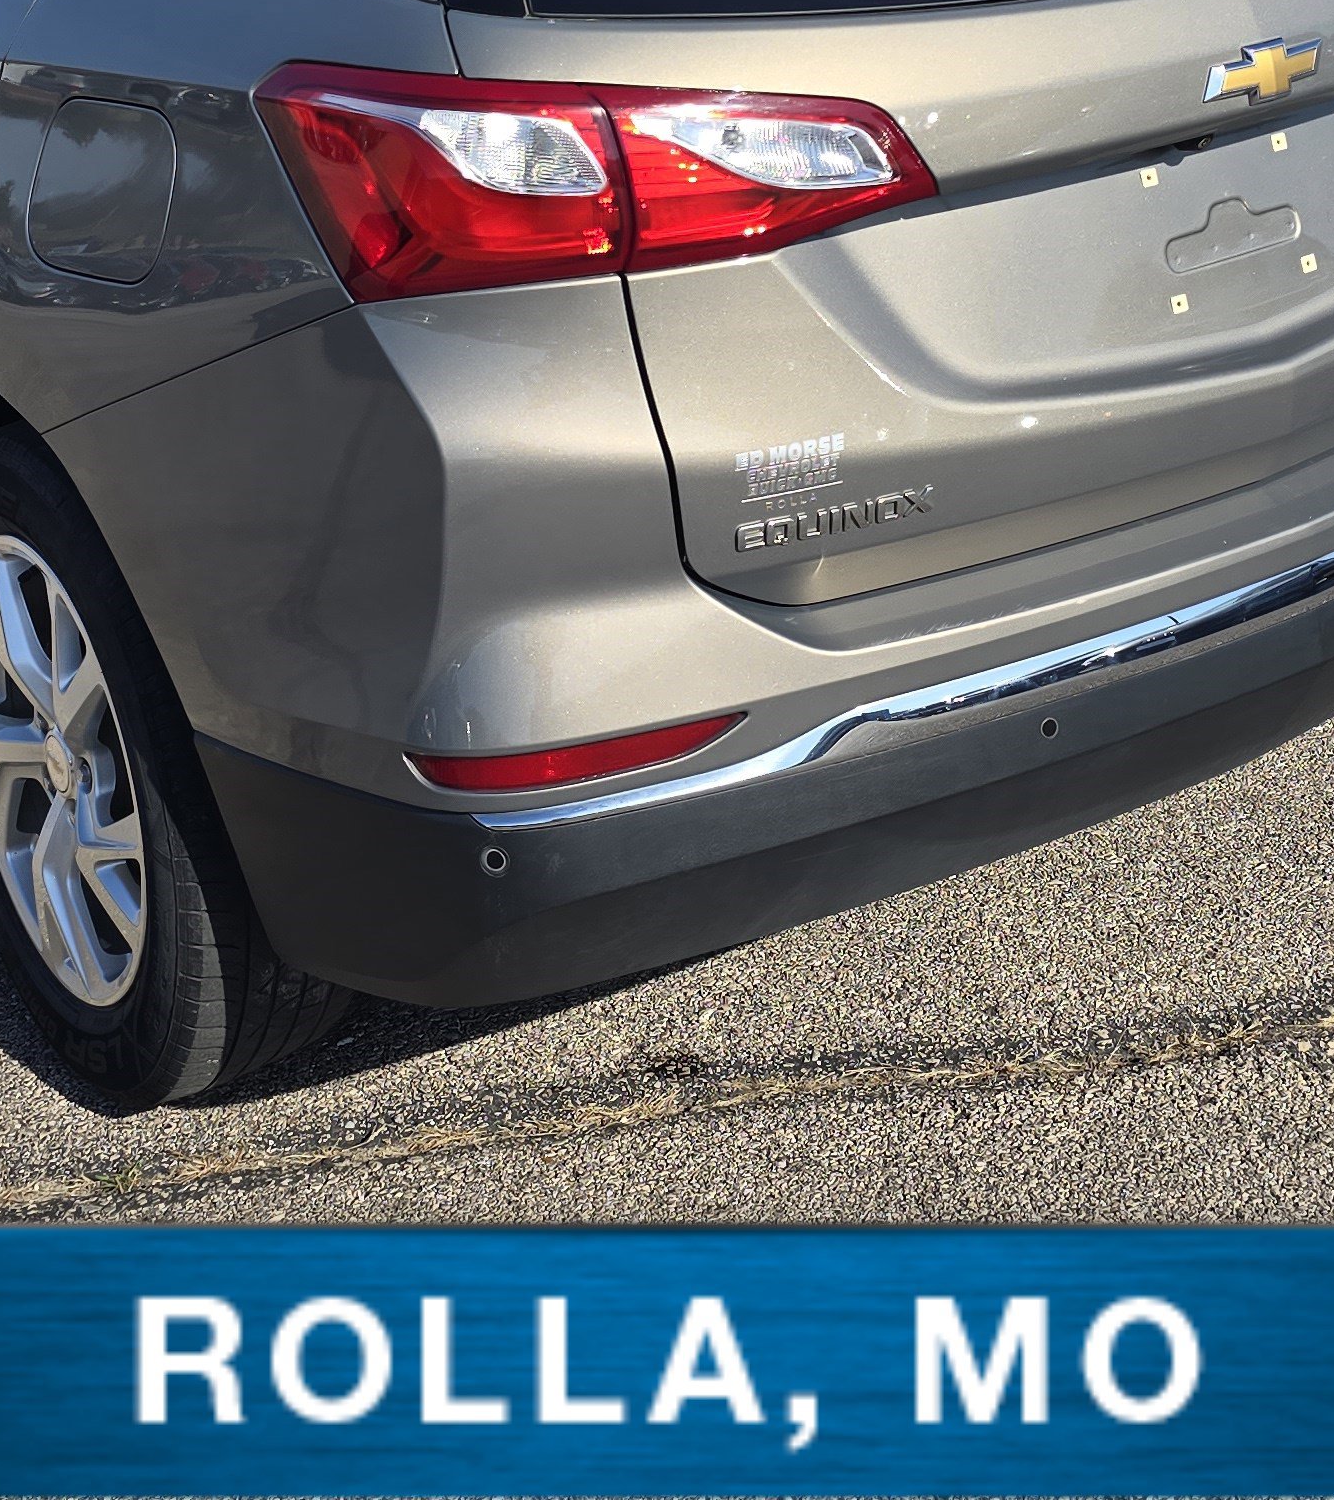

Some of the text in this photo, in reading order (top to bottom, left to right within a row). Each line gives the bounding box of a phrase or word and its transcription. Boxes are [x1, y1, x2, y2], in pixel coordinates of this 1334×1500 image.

[735, 432, 845, 471] ED MORSE
[734, 484, 934, 553] EQUINOX
[765, 492, 818, 511] ROLLA
